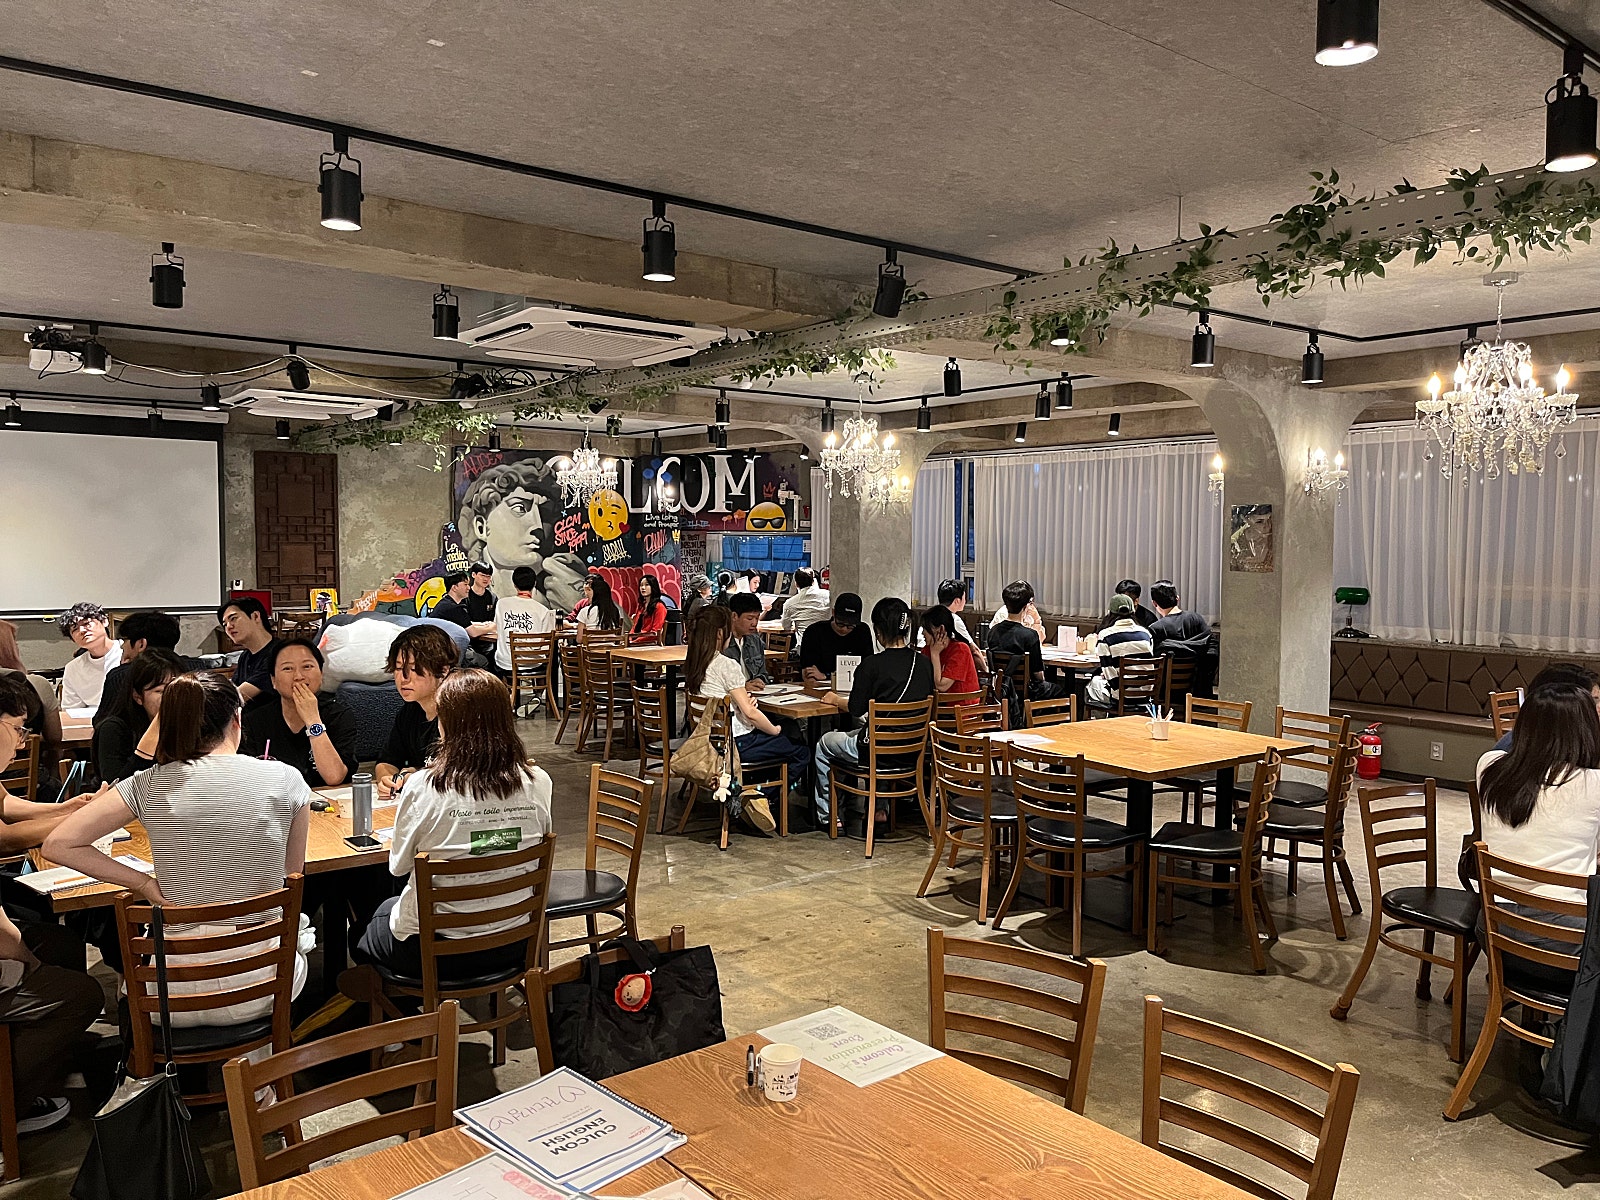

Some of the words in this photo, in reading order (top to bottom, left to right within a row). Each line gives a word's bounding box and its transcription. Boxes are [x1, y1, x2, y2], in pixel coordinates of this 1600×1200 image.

[464, 453, 497, 478] ALICE
[645, 513, 660, 521] Live
[823, 1034, 899, 1062] Presentation
[851, 1044, 904, 1066] Culcom's
[541, 1117, 608, 1147] ENGLISH
[549, 1124, 617, 1156] CULCOM
